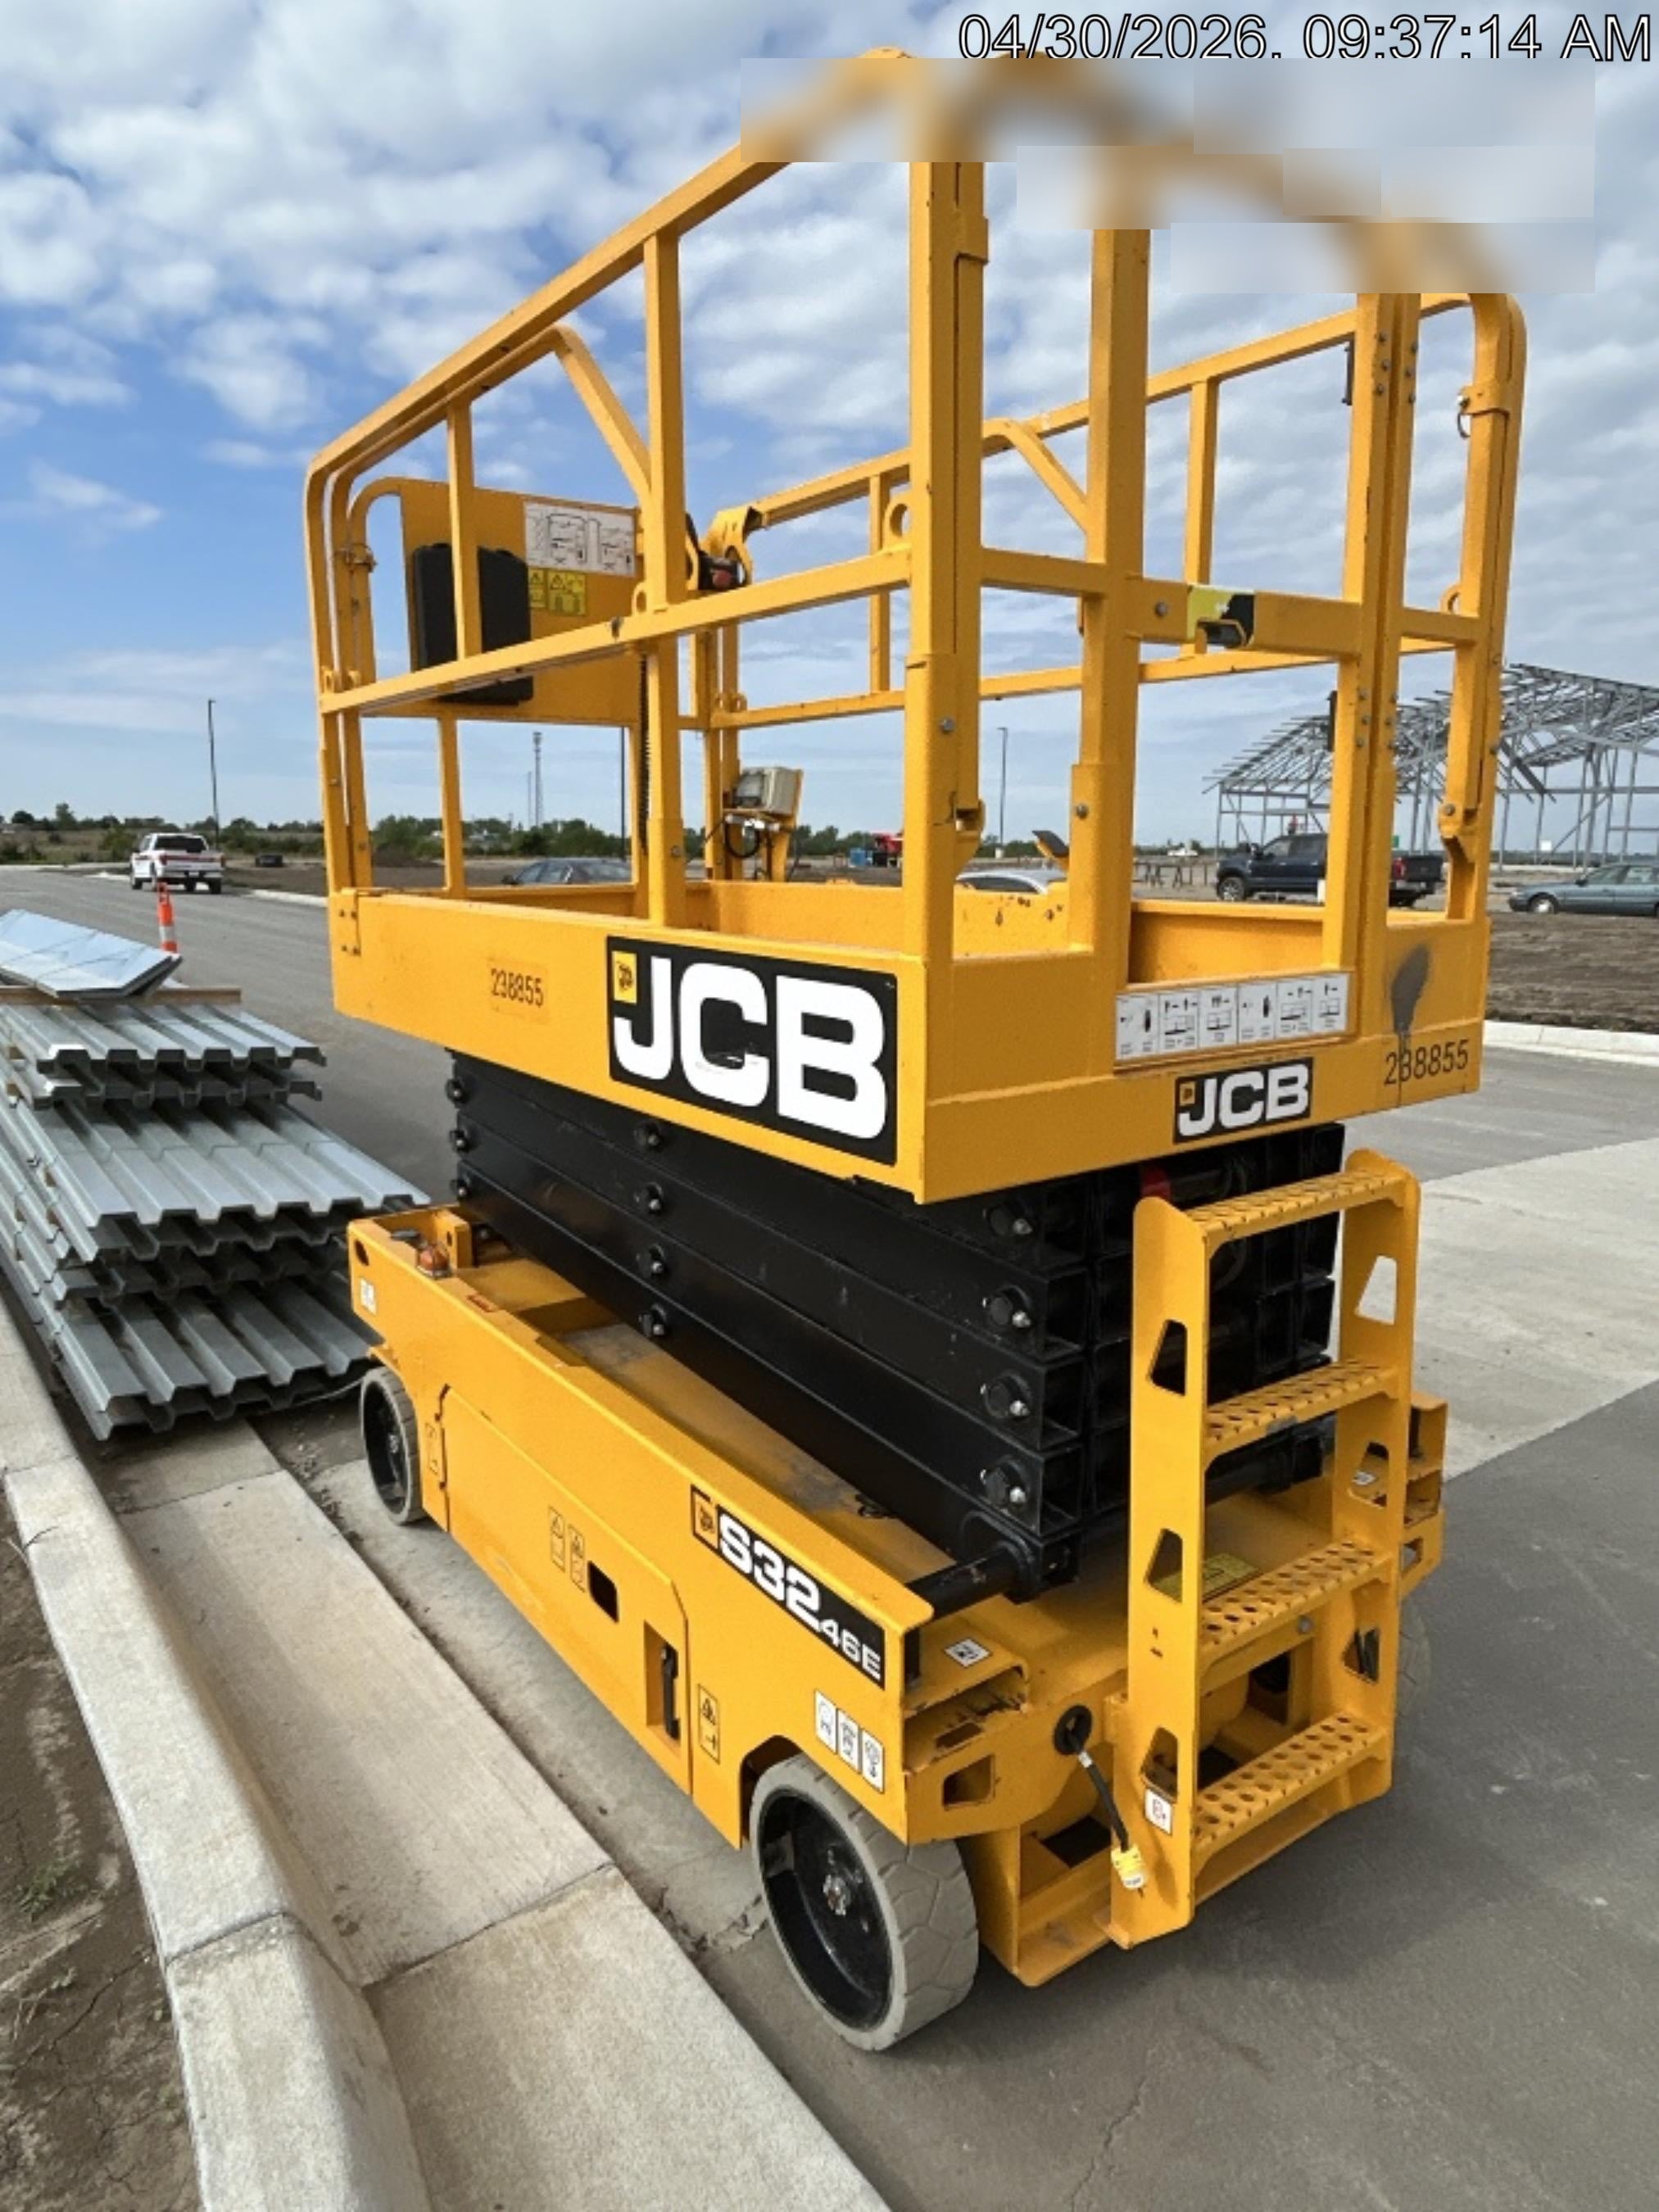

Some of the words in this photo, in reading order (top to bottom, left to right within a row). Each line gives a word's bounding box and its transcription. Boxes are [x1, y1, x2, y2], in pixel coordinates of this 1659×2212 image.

[491, 968, 544, 1008] 238855
[613, 955, 888, 1140] JCB
[1178, 1064, 1308, 1136] JCB
